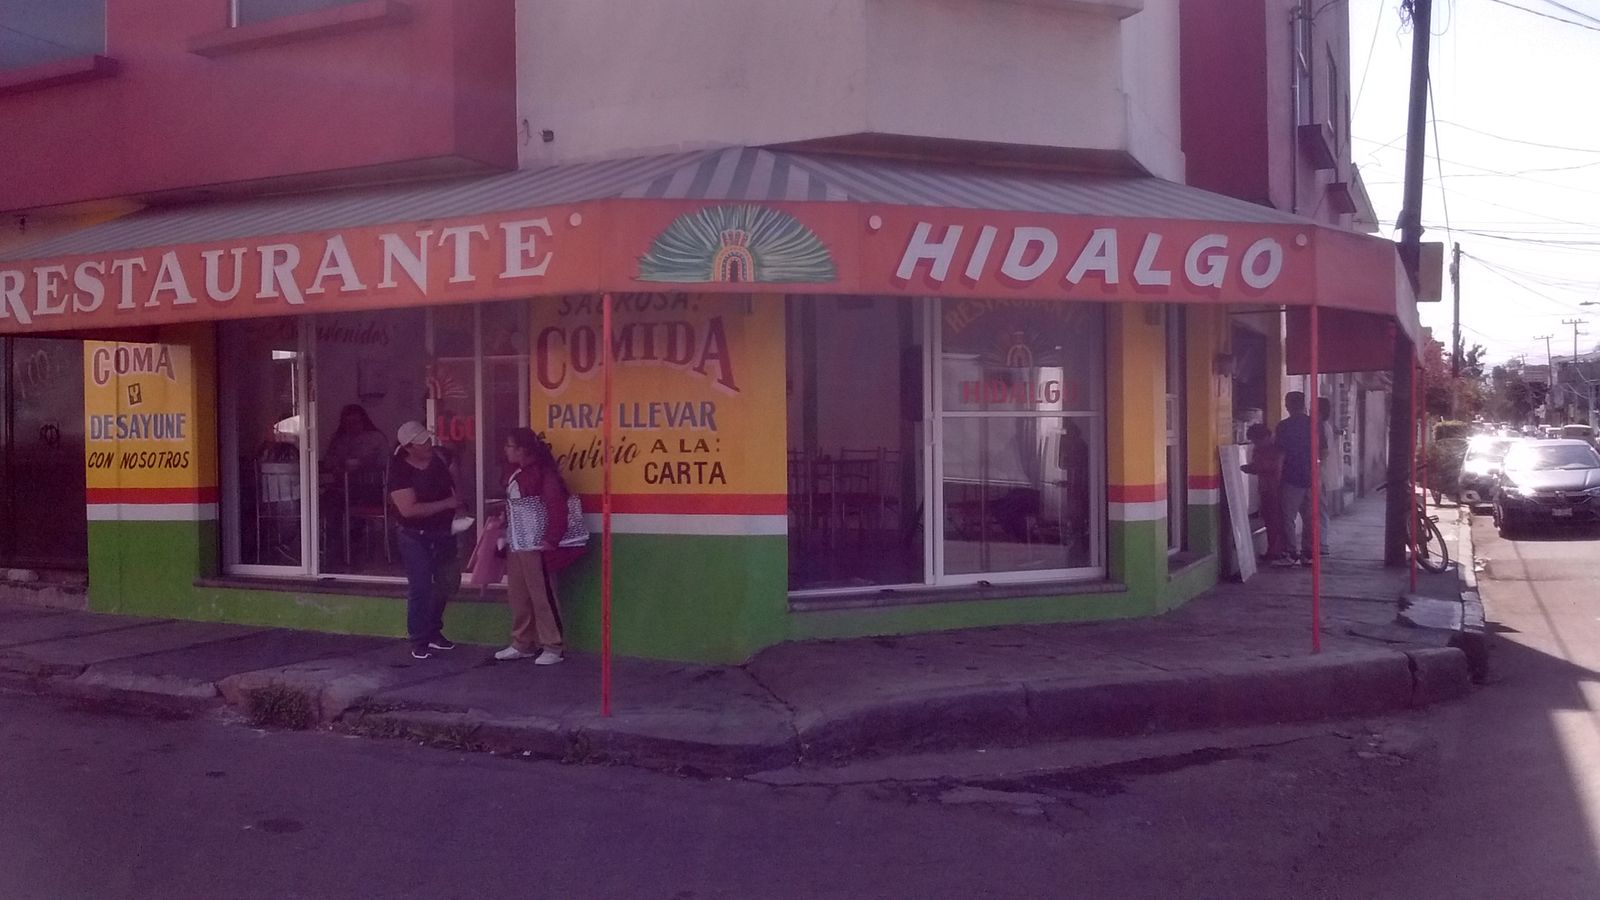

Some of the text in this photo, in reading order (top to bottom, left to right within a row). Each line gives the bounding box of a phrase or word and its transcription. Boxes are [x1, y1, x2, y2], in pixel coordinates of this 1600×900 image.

[896, 221, 1284, 289] HIDALGO
[0, 217, 553, 325] RESTAURANTE
[93, 346, 176, 386] COMA
[536, 315, 740, 393] COMIDA
[960, 381, 1079, 404] HIDALGO
[90, 412, 187, 440] DESAYUNE
[548, 401, 717, 431] PARA LLEVAR
[88, 451, 190, 469] CON NOSOTROS
[650, 438, 668, 454] A
[644, 461, 727, 485] CARTA
